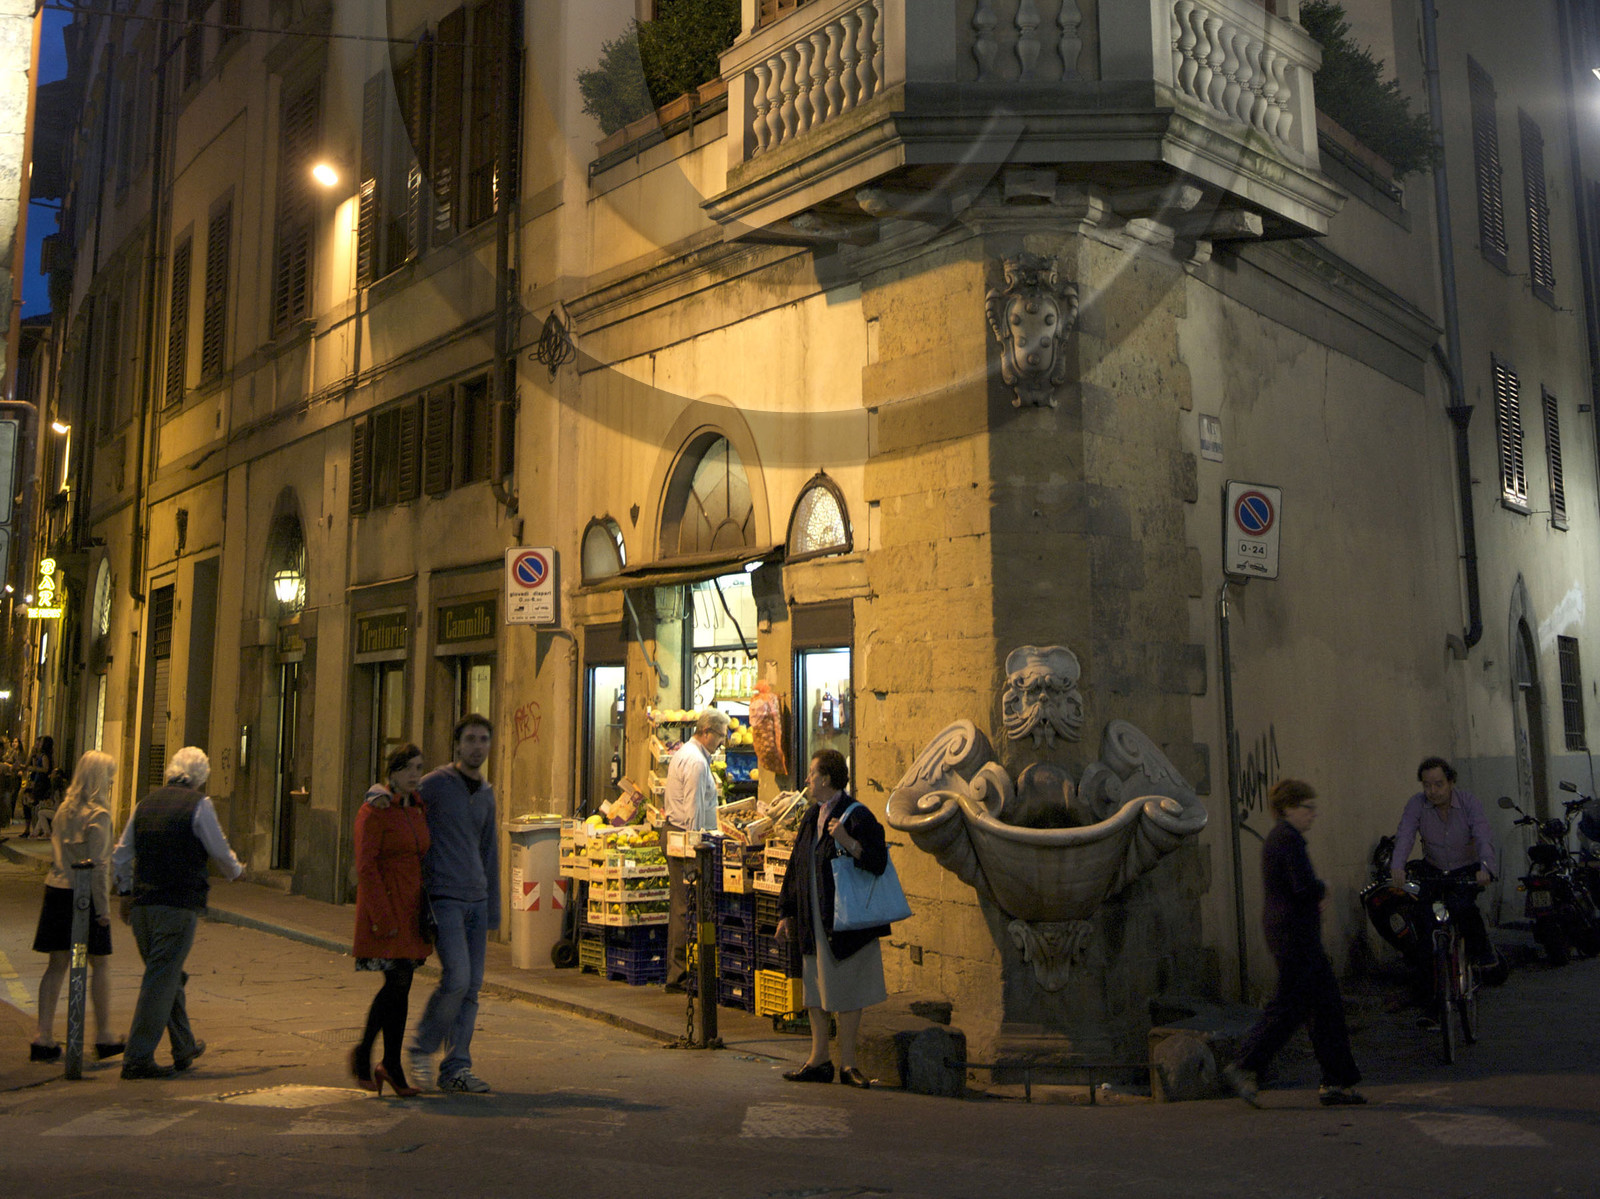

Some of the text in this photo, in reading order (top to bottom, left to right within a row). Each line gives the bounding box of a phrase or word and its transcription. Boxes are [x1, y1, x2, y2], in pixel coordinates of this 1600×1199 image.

[38, 558, 56, 607] BAR
[361, 617, 405, 652] Trattoria
[446, 607, 491, 639] Cammillo
